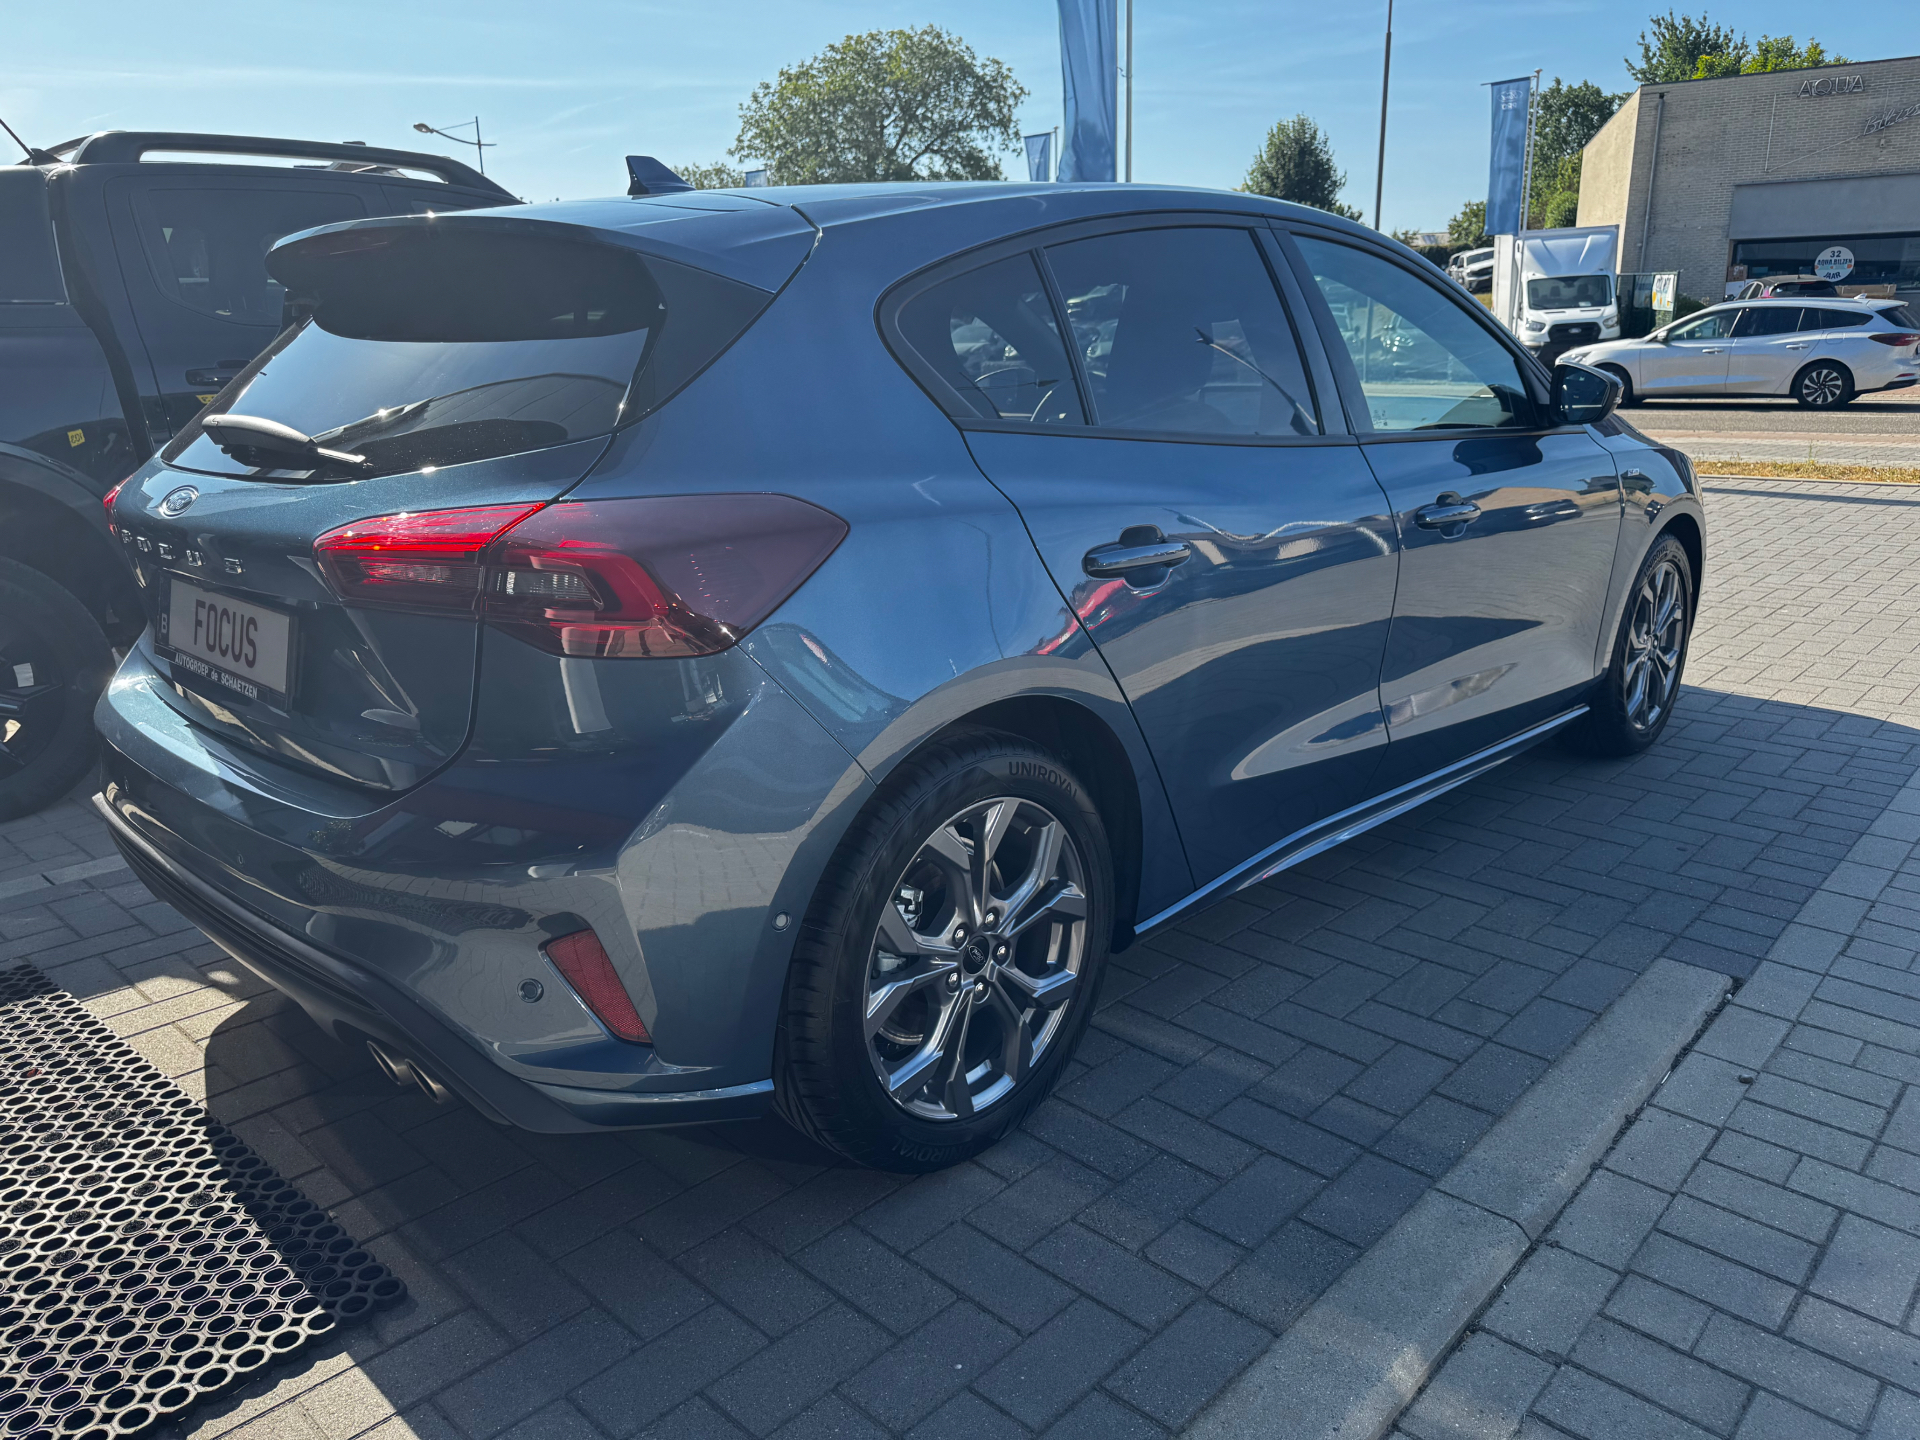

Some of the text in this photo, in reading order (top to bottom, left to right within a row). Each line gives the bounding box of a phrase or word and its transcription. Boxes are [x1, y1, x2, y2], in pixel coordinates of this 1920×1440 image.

[1797, 74, 1865, 97] AQUA
[1830, 250, 1842, 258] 32
[1833, 258, 1853, 266] BILZEN
[1823, 271, 1842, 280] JAAR
[161, 612, 168, 635] B
[194, 599, 258, 669] FOCUS
[174, 652, 258, 699] AUTOGROEP de SCHAETZEN
